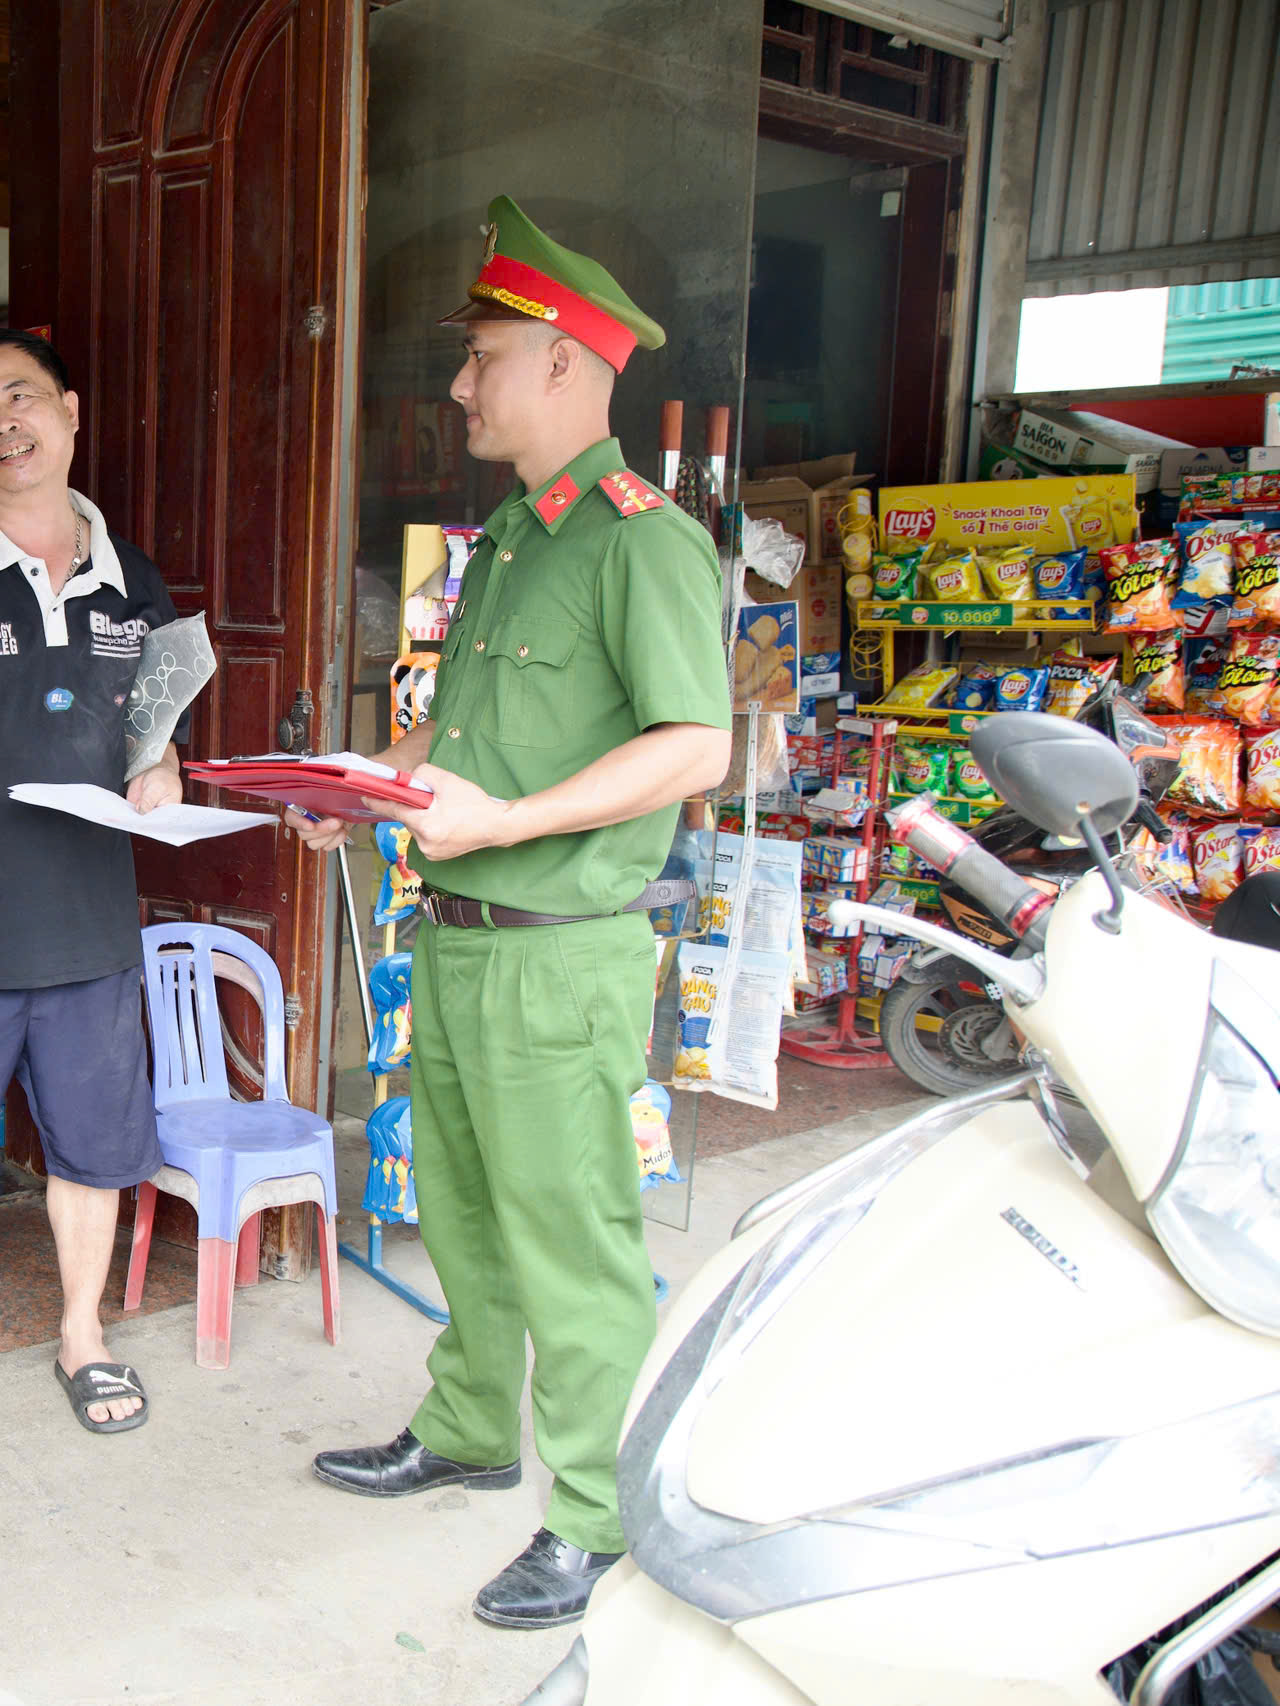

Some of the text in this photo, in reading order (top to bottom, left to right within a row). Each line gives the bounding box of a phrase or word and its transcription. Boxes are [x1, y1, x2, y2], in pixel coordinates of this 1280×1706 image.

[1021, 424, 1066, 453] SAIGON
[953, 506, 1050, 520] Snack Khoai Tây
[887, 509, 933, 538] Lay's
[978, 520, 986, 534] 1
[1051, 665, 1082, 680] POCA
[96, 1384, 126, 1395] PUMA
